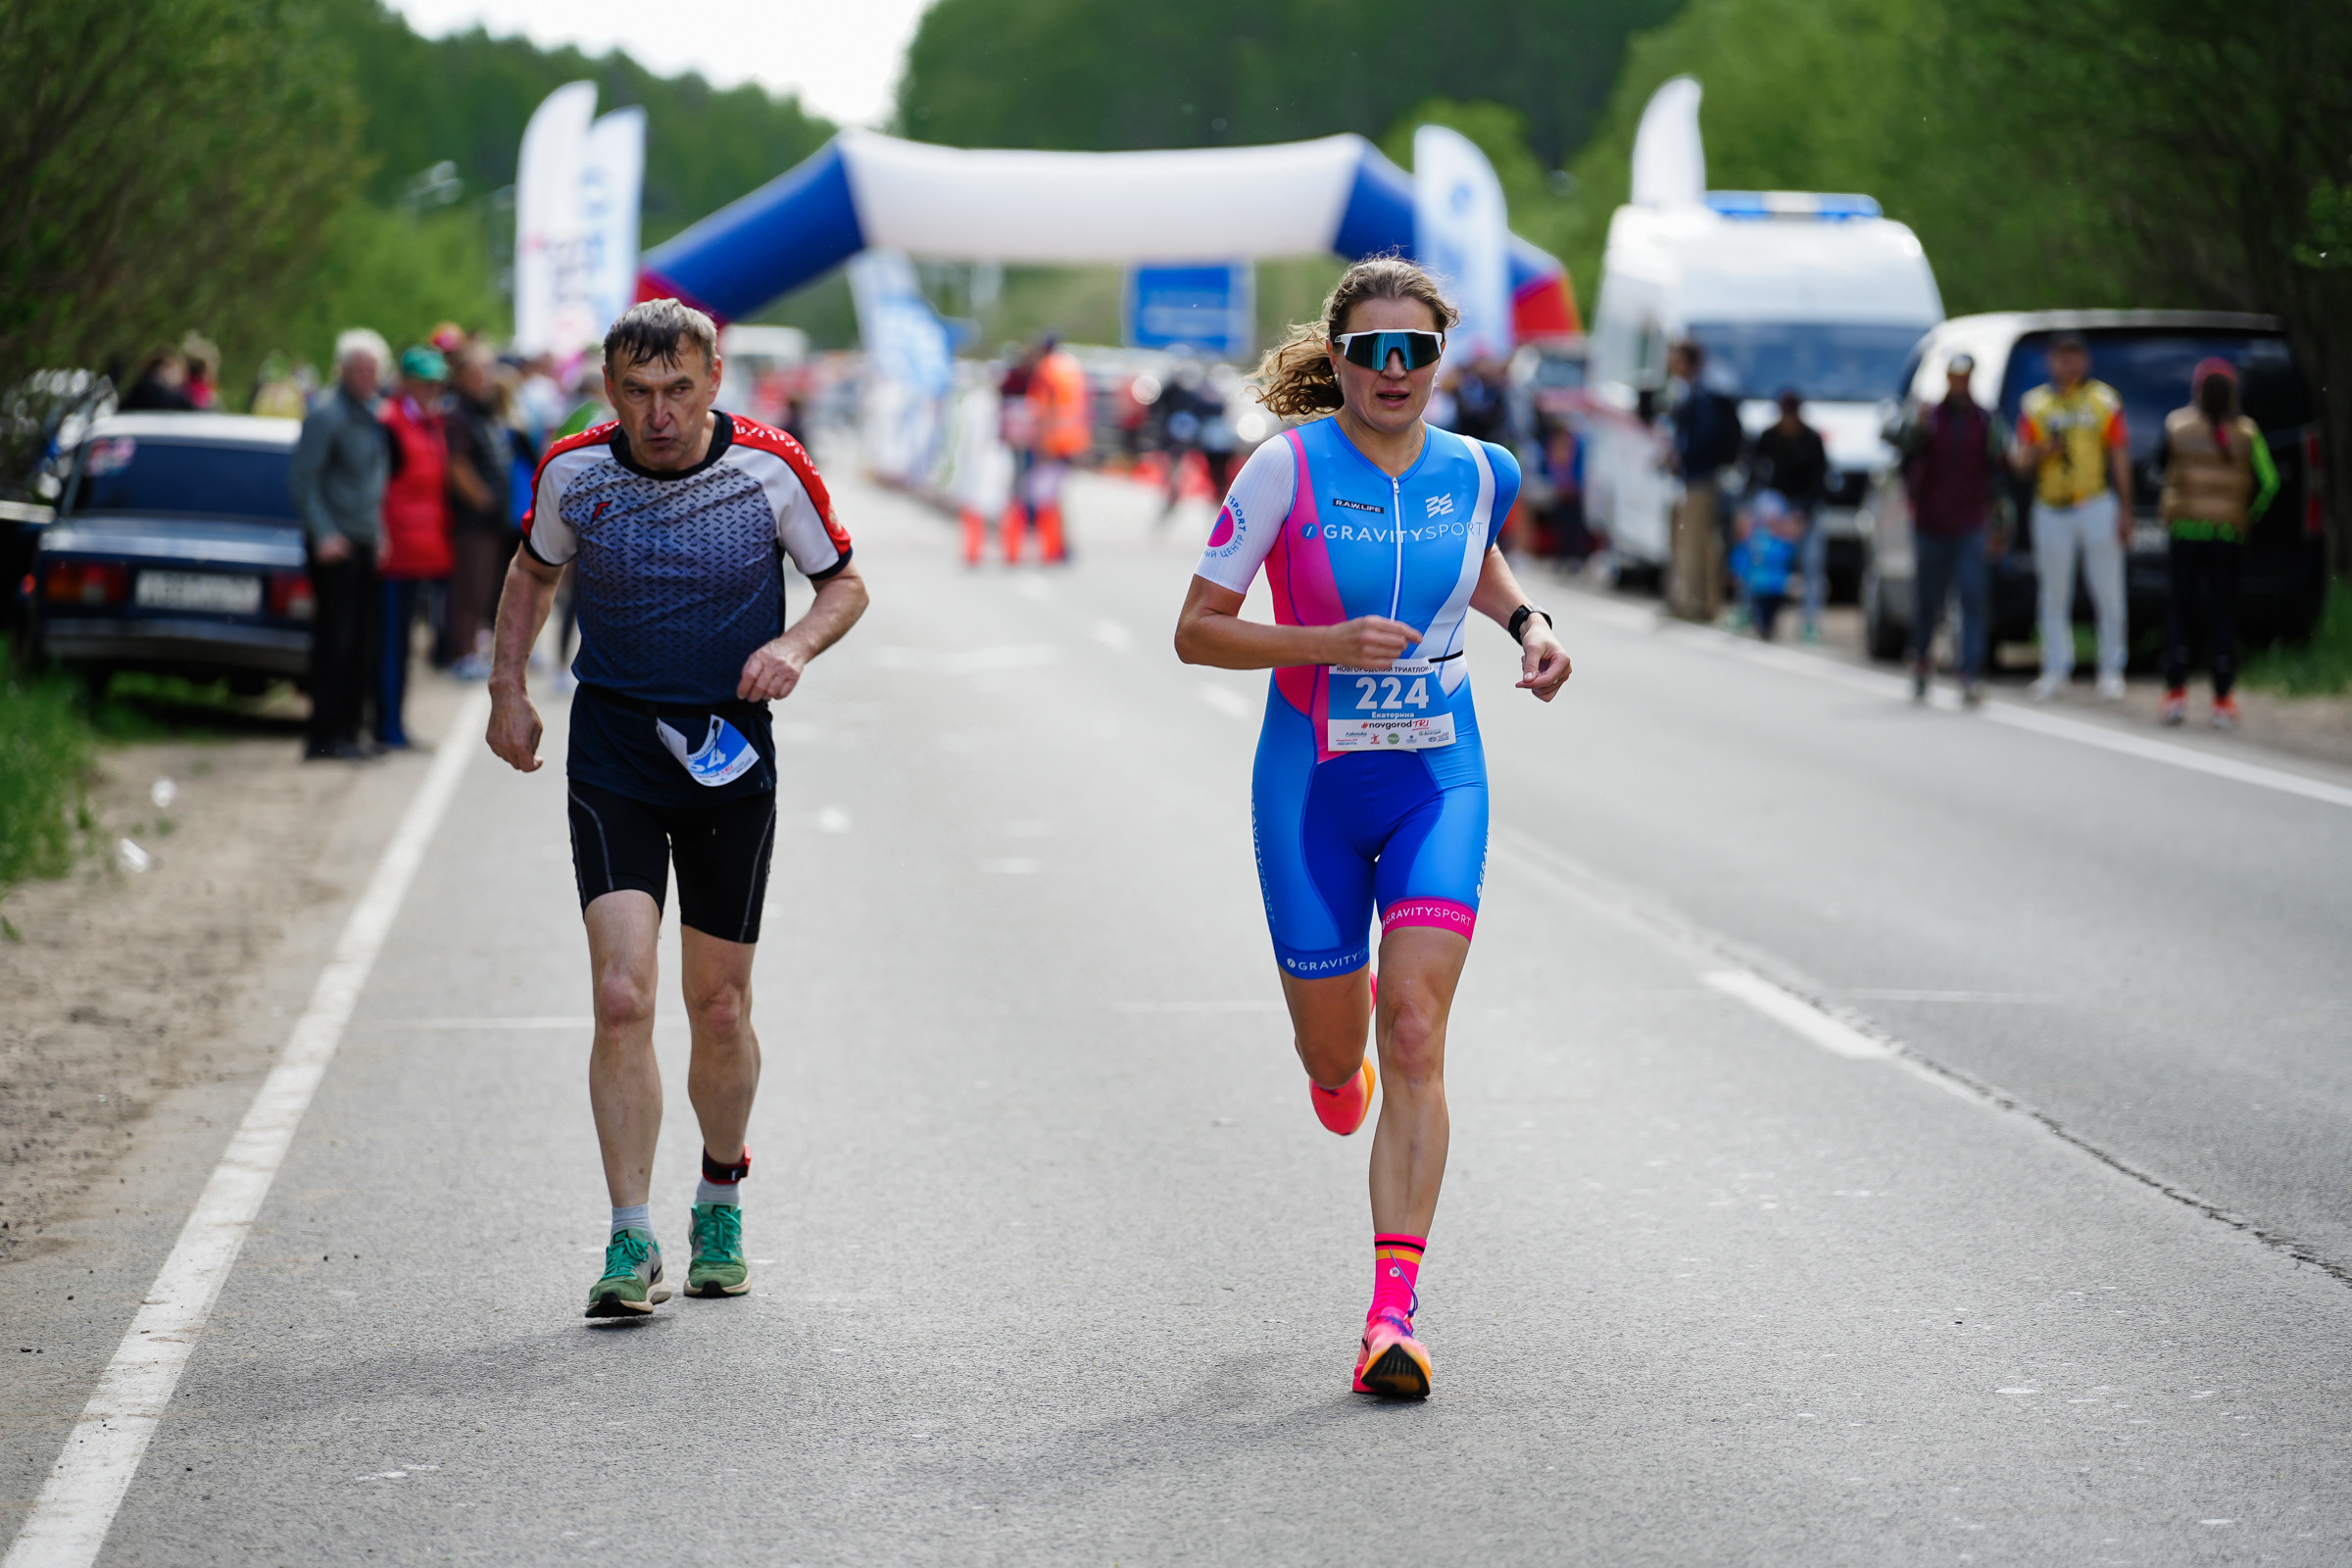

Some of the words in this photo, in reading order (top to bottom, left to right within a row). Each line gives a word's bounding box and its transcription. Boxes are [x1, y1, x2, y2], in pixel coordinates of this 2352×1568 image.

[1228, 493, 1247, 532] YSPORT
[1323, 521, 1483, 543] GRAVITYSPORT
[1219, 534, 1245, 558] ЦЕНТР
[1355, 676, 1430, 710] 224
[1385, 906, 1471, 927] GRAVITYSPORT
